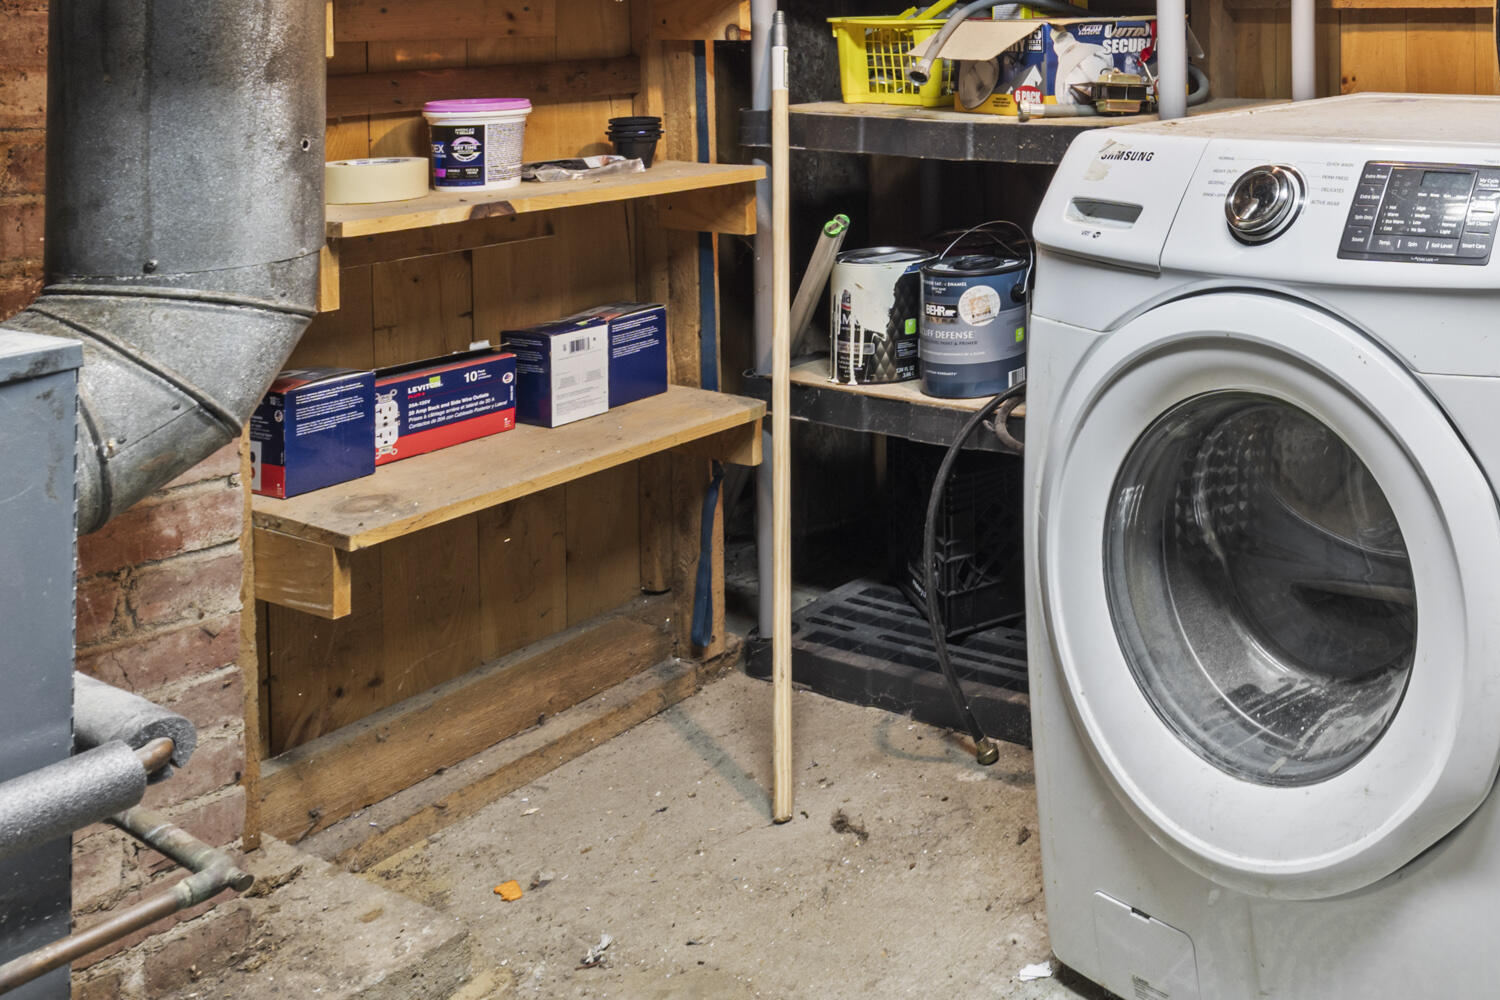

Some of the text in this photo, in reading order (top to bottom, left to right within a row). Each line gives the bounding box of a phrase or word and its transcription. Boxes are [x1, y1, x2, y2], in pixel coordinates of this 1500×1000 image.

[1102, 38, 1152, 54] SECURI
[1015, 91, 1041, 104] 6 PACK
[925, 303, 946, 315] BEHR
[935, 330, 975, 339] DEFENSE
[463, 370, 478, 383] 10
[408, 382, 441, 394] LEVIT
